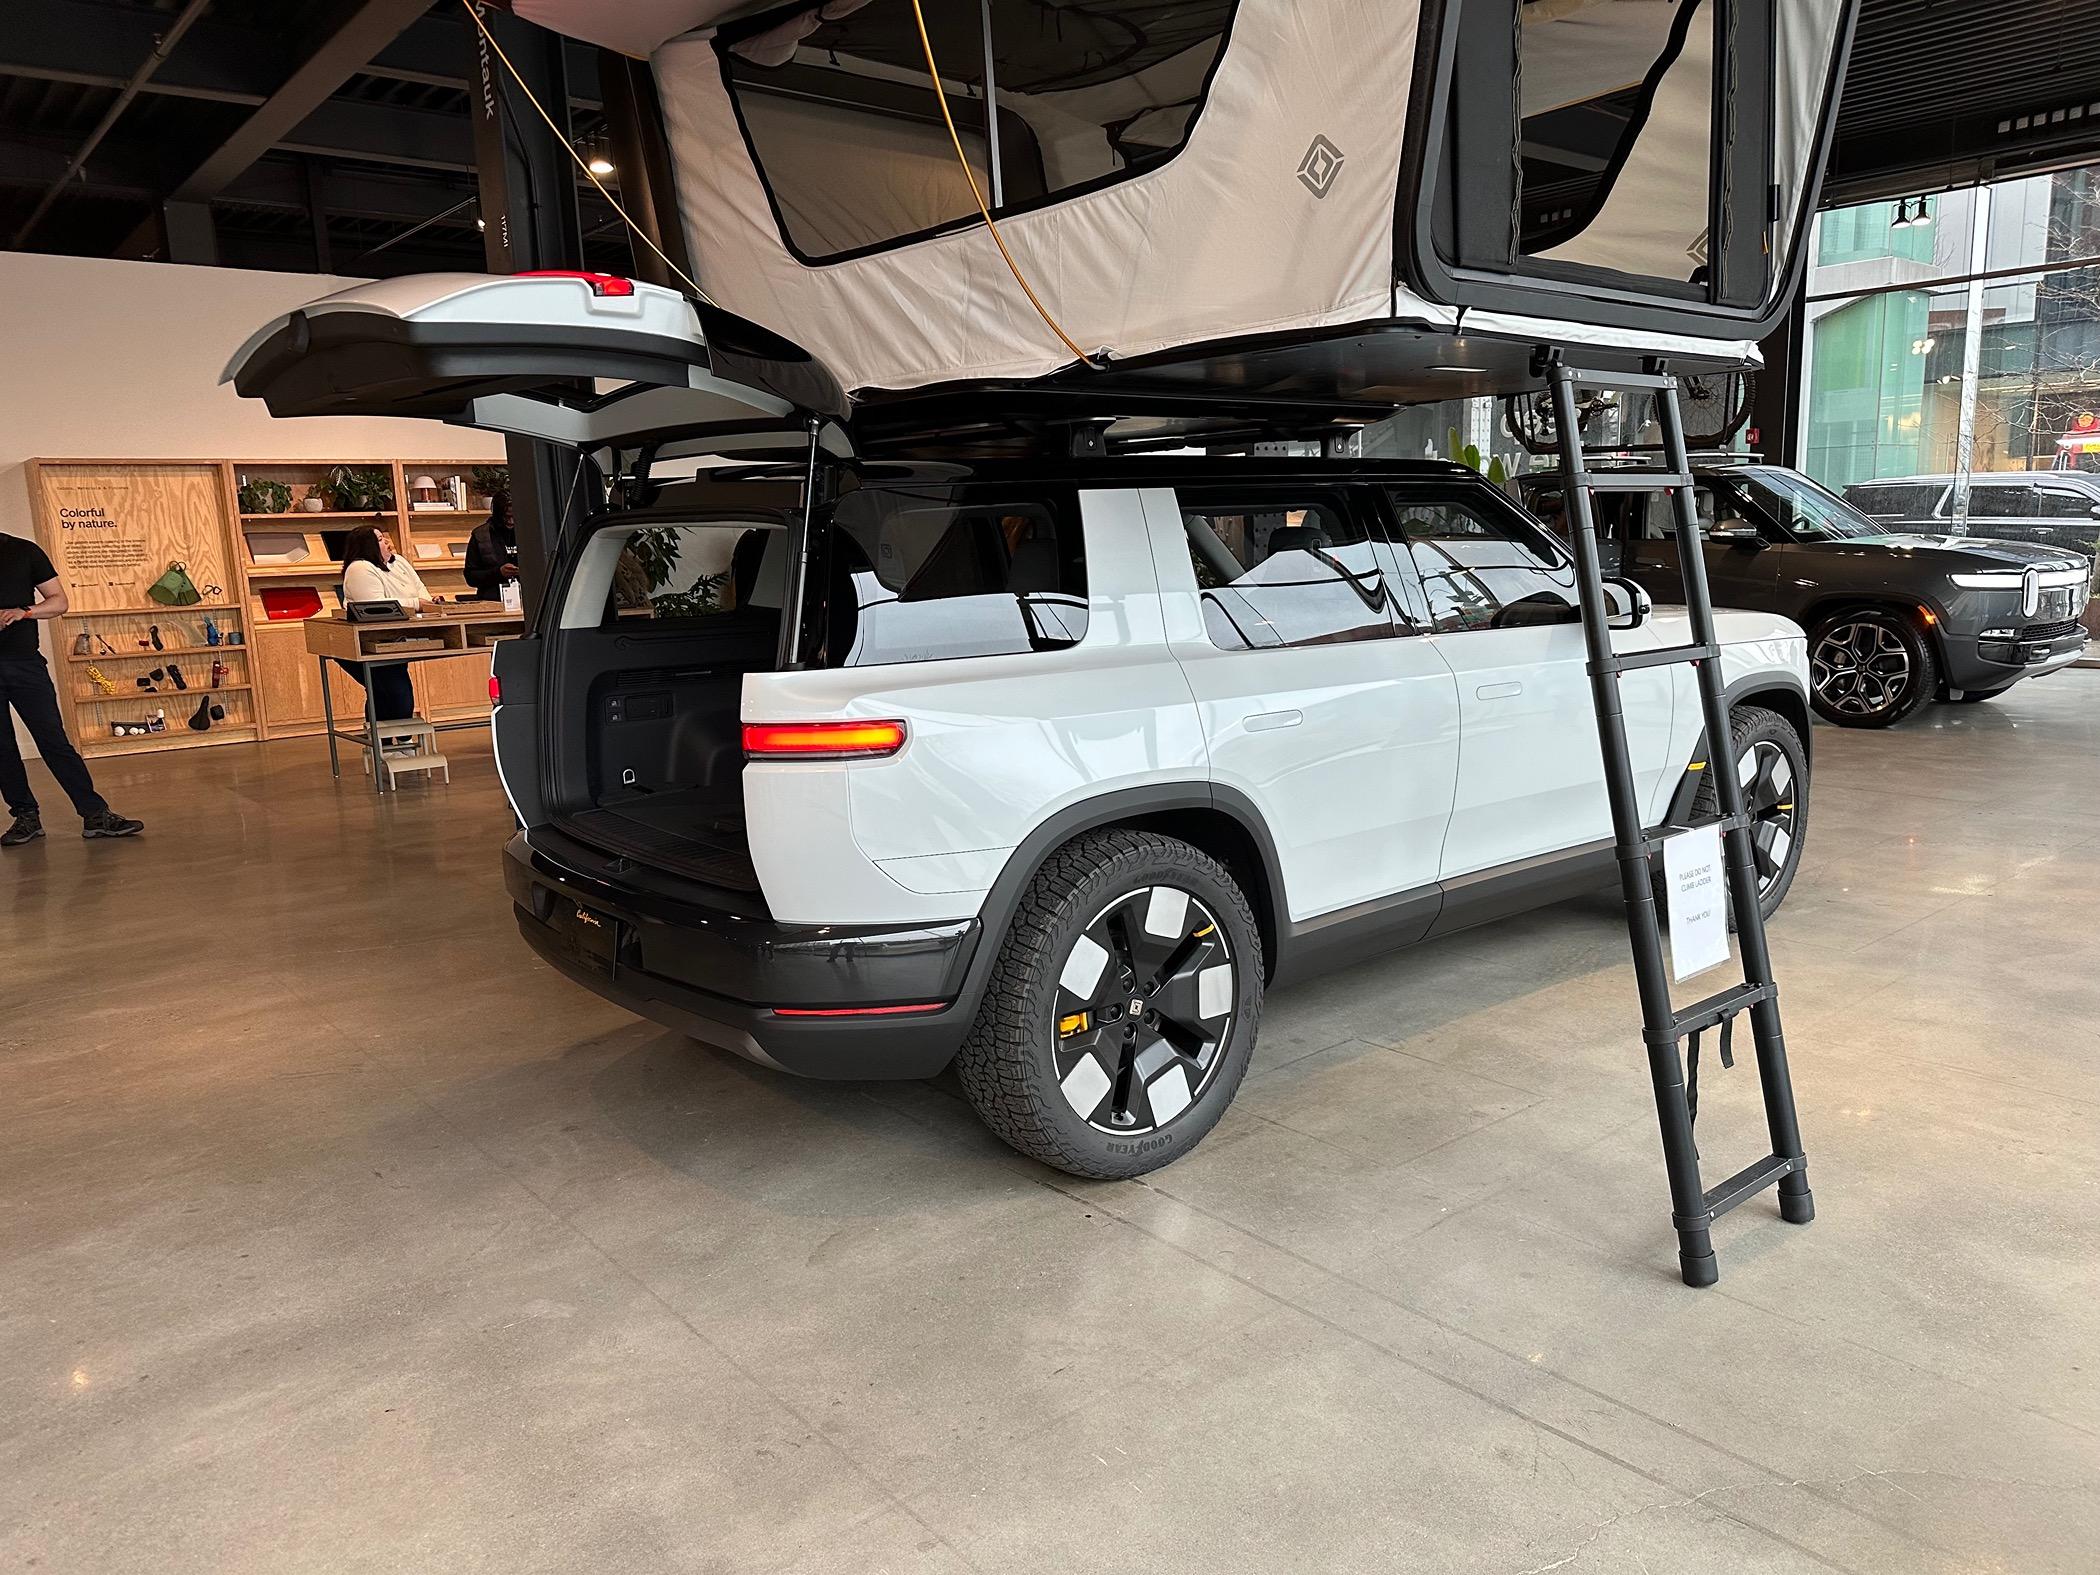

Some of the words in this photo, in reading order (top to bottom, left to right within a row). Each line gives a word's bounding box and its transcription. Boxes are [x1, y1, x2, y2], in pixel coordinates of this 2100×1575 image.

[60, 507, 105, 518] Colorful
[61, 519, 76, 531] by
[78, 519, 118, 529] nature.
[1679, 869, 1694, 881] PLEASE
[1702, 863, 1711, 873] NOT
[1695, 875, 1712, 888] LADDER
[1106, 1134, 1173, 1157] GOODYEAR
